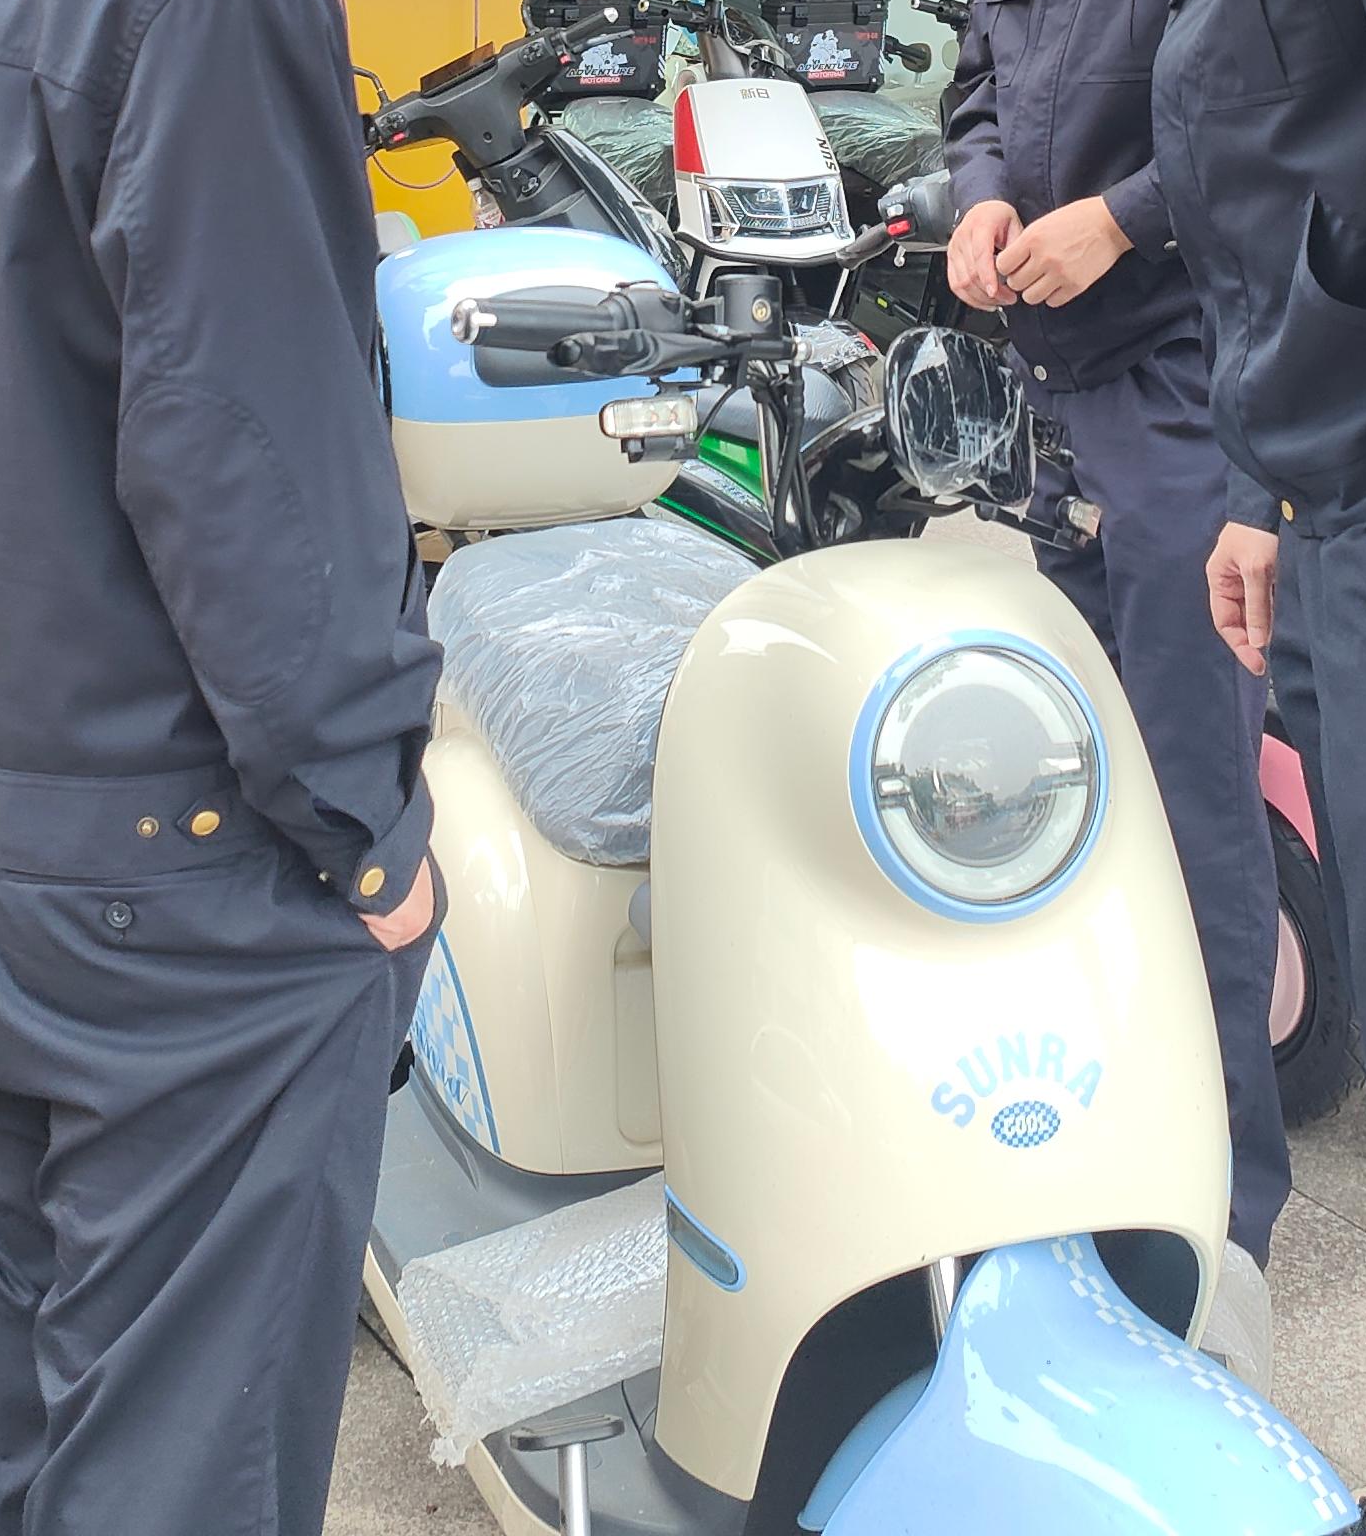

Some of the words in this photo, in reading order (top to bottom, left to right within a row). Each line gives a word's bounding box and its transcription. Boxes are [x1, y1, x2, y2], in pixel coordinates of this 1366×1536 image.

[565, 65, 637, 78] ADVENTURE
[796, 60, 860, 72] ADVENTURE
[739, 87, 771, 100] 新日
[930, 1030, 1103, 1130] SUNRA
